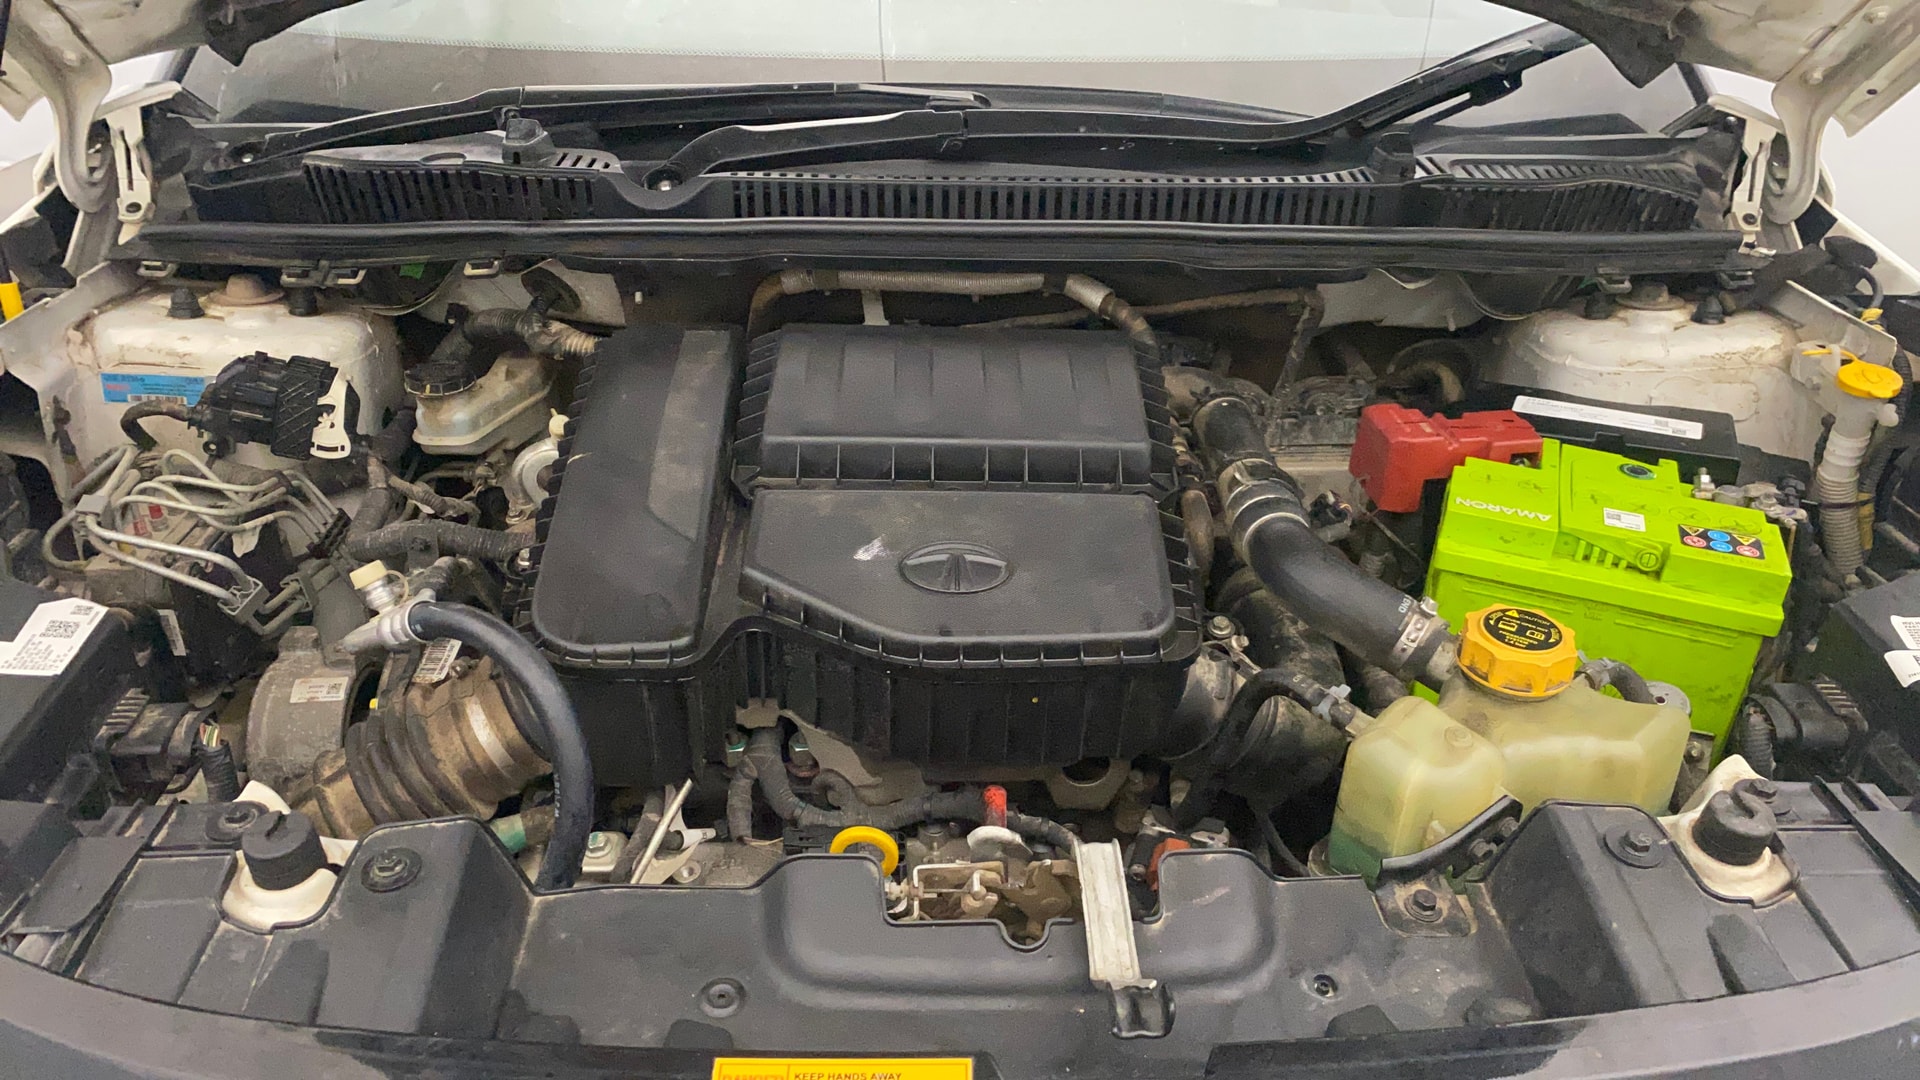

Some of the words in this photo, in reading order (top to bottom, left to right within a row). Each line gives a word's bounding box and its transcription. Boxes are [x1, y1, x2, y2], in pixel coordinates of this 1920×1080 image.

[1455, 497, 1551, 521] AMARON
[1519, 613, 1550, 626] CAUTION
[794, 1072, 825, 1080] KEEP
[828, 1072, 867, 1080] HANDS
[870, 1072, 902, 1080] AWAY
